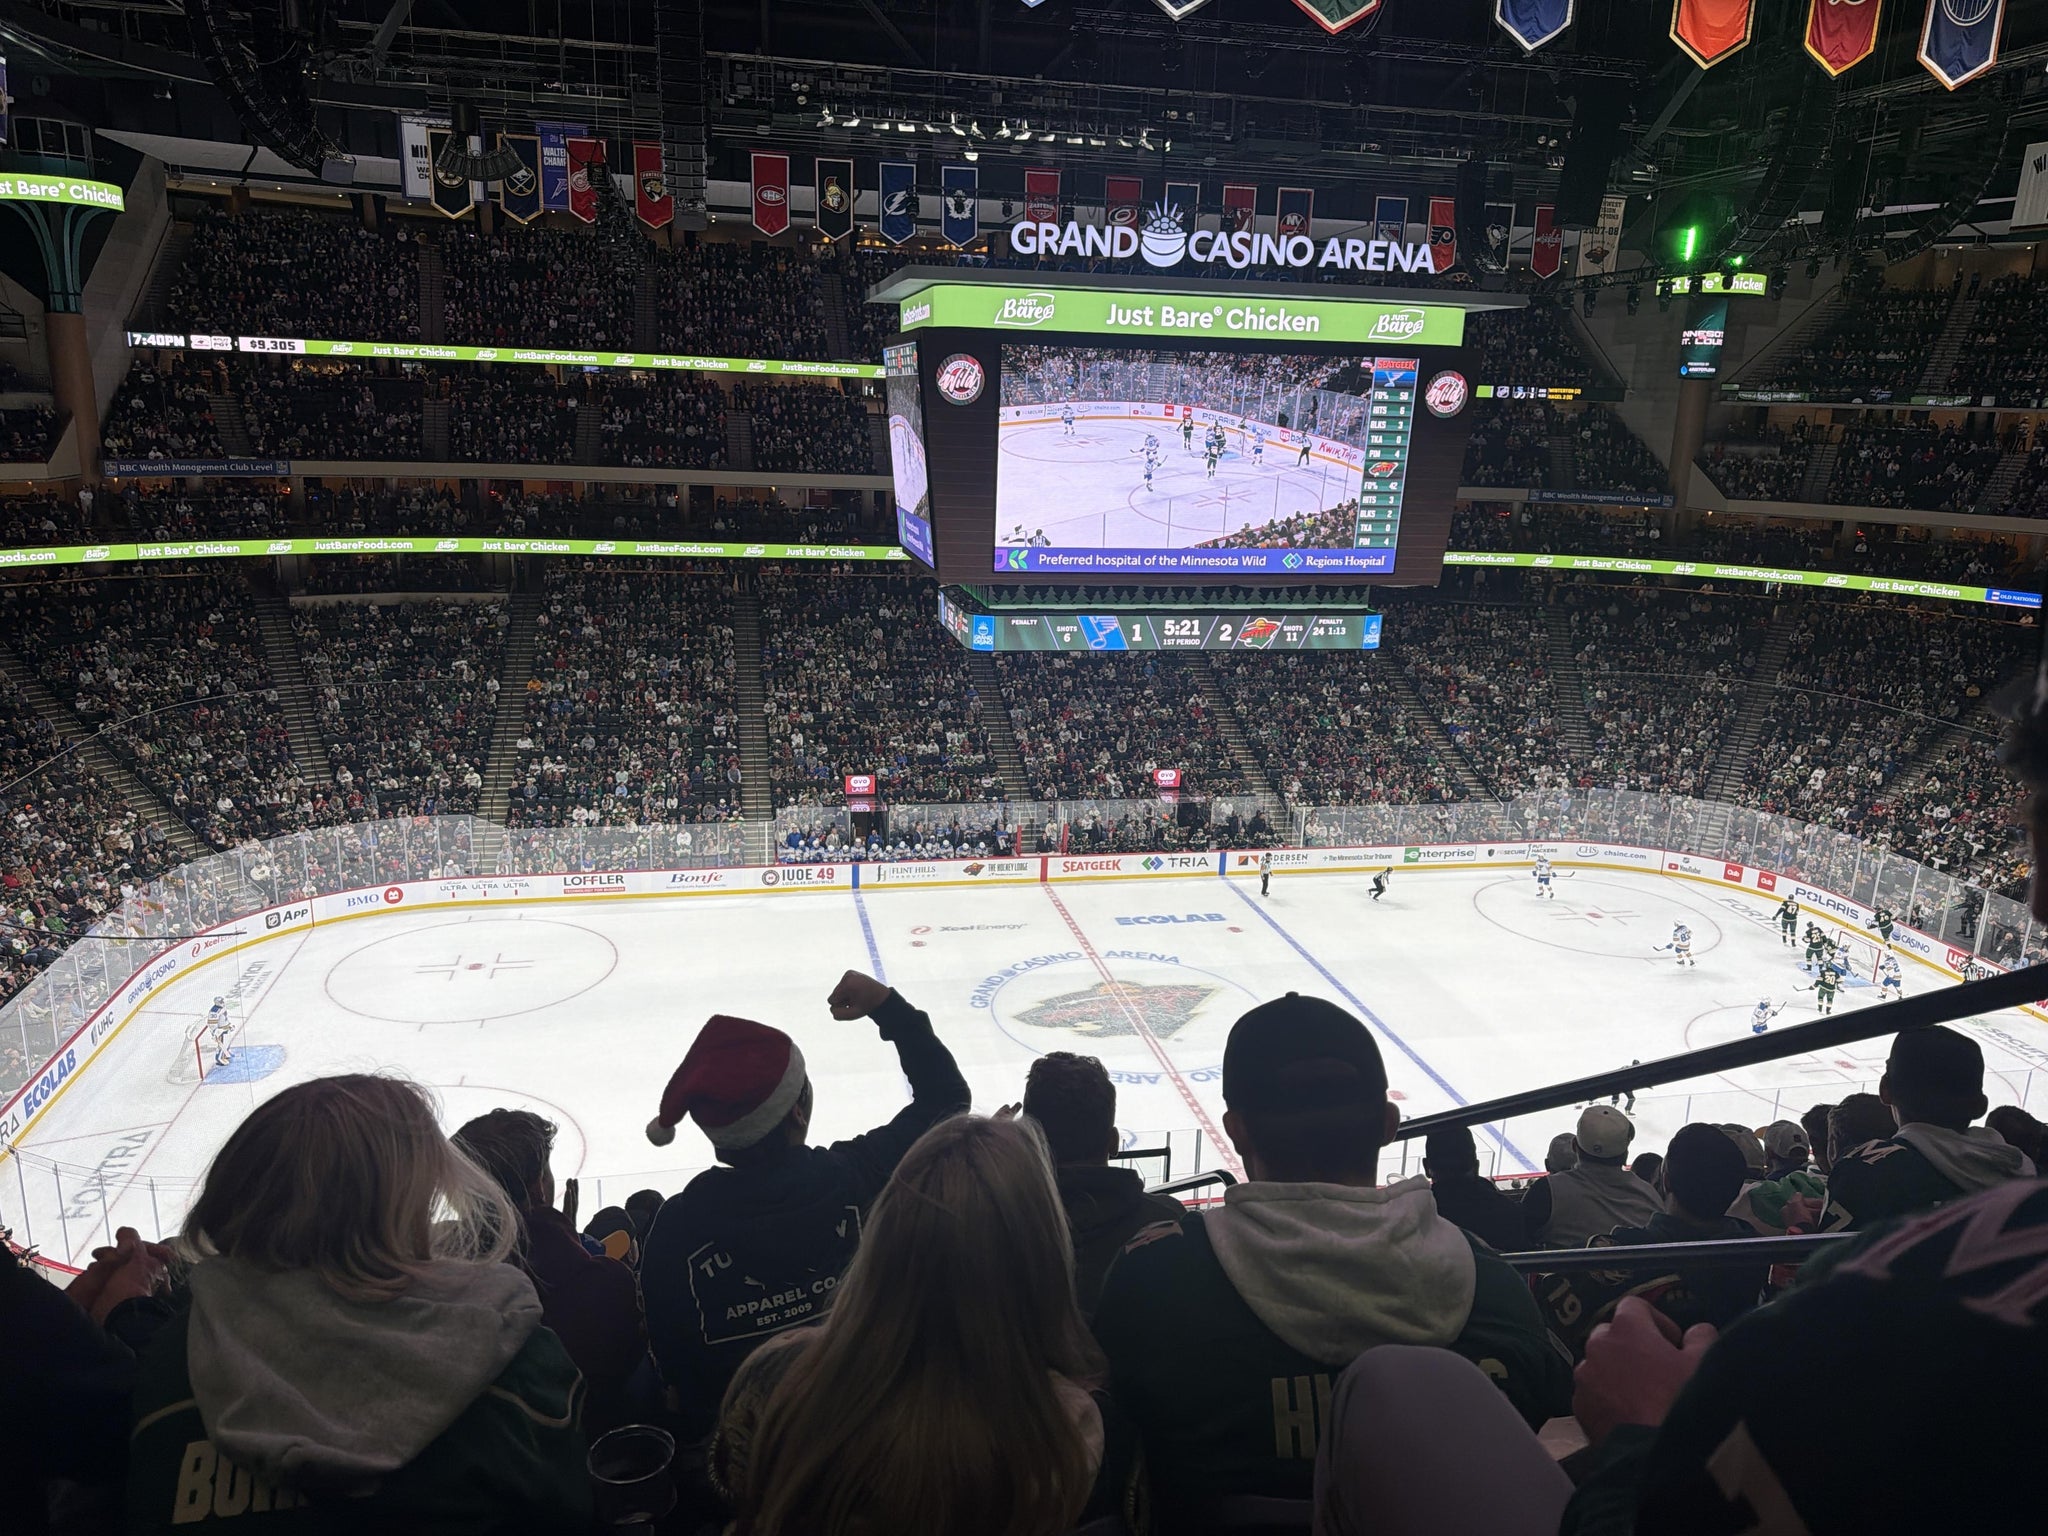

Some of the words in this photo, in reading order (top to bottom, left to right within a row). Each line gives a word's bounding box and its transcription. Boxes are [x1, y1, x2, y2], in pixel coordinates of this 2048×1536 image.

[70, 184, 122, 206] Chicken
[1011, 221, 1138, 258] GRAND
[1188, 230, 1314, 268] CASINO
[1318, 238, 1436, 274] ARENA
[1106, 304, 1154, 326] Just
[1226, 307, 1320, 332] Chicken
[132, 334, 185, 346] 7:40PM
[372, 346, 392, 356] Just
[419, 348, 456, 358] Chicken
[513, 351, 598, 362] JustBareFoods.com
[652, 357, 669, 366] Just
[694, 359, 728, 370] Chicken
[782, 364, 858, 374] JustBareFoods.com
[1377, 360, 1416, 370] SEATGEEK
[1202, 412, 1236, 426] POLARIS
[120, 464, 137, 472] RBC
[139, 464, 170, 472] Wealth
[172, 463, 228, 474] Management
[230, 463, 248, 472] Club
[250, 463, 272, 472] Level
[1582, 494, 1624, 502] Management
[139, 546, 162, 557] Just
[196, 544, 240, 554] Chicken
[314, 540, 413, 550] JustBareFoods.com
[482, 542, 502, 550] Just
[530, 542, 570, 552] Chicken
[635, 544, 724, 554] JustBareFoods.com
[786, 548, 804, 557] Just
[830, 548, 865, 558] Chicken
[1039, 554, 1092, 566] Preferred
[1096, 554, 1141, 568] hospital
[1144, 554, 1157, 566] of
[1158, 555, 1178, 566] the
[1180, 556, 1238, 566] Minnesota
[1242, 556, 1266, 566] Wild
[1306, 556, 1342, 568] Regions
[1344, 556, 1386, 568] Hospital
[1572, 559, 1590, 568] Just
[1616, 561, 1652, 570] Chicken
[1714, 566, 1803, 581] JustBareFoods.com
[1870, 580, 1890, 590] Just
[1920, 585, 1960, 597] Chicken
[1132, 624, 1142, 642] 1
[1164, 620, 1200, 636] 5:21
[1220, 624, 1232, 641] 2
[1312, 626, 1325, 636] 24
[1328, 627, 1346, 636] 1:13
[1064, 632, 1070, 642] 6
[1286, 632, 1297, 642] 11
[1261, 854, 1308, 864] ADERSEN
[1408, 849, 1474, 860] enterprise
[1579, 846, 1597, 854] CHS
[1604, 850, 1647, 860] chsinc.com
[1014, 862, 1028, 870] LODGE
[1063, 859, 1122, 872] SEATGEEK
[1168, 857, 1208, 868] TRIA
[782, 868, 812, 880] IUOE
[816, 868, 834, 880] 49
[1680, 866, 1702, 874] YouTube
[564, 874, 624, 886] LOFFLER
[671, 872, 724, 884] Bonfe
[347, 894, 380, 908] BMO
[1794, 887, 1859, 920] POLARIS
[1114, 913, 1227, 926] ECOLAB
[939, 924, 974, 932] Xcel
[1902, 934, 1930, 954] CASINO
[128, 982, 146, 1004] GRAND
[150, 958, 176, 984] CASINO
[970, 972, 1004, 1009] GRAND
[1012, 951, 1082, 972] CASINO
[1104, 950, 1180, 964] ARENA
[97, 1012, 116, 1037] UHC
[24, 1048, 76, 1120] ECOLAB
[726, 1288, 806, 1320] APPAREL
[757, 1313, 782, 1326] EST.
[784, 1302, 812, 1318] 2009
